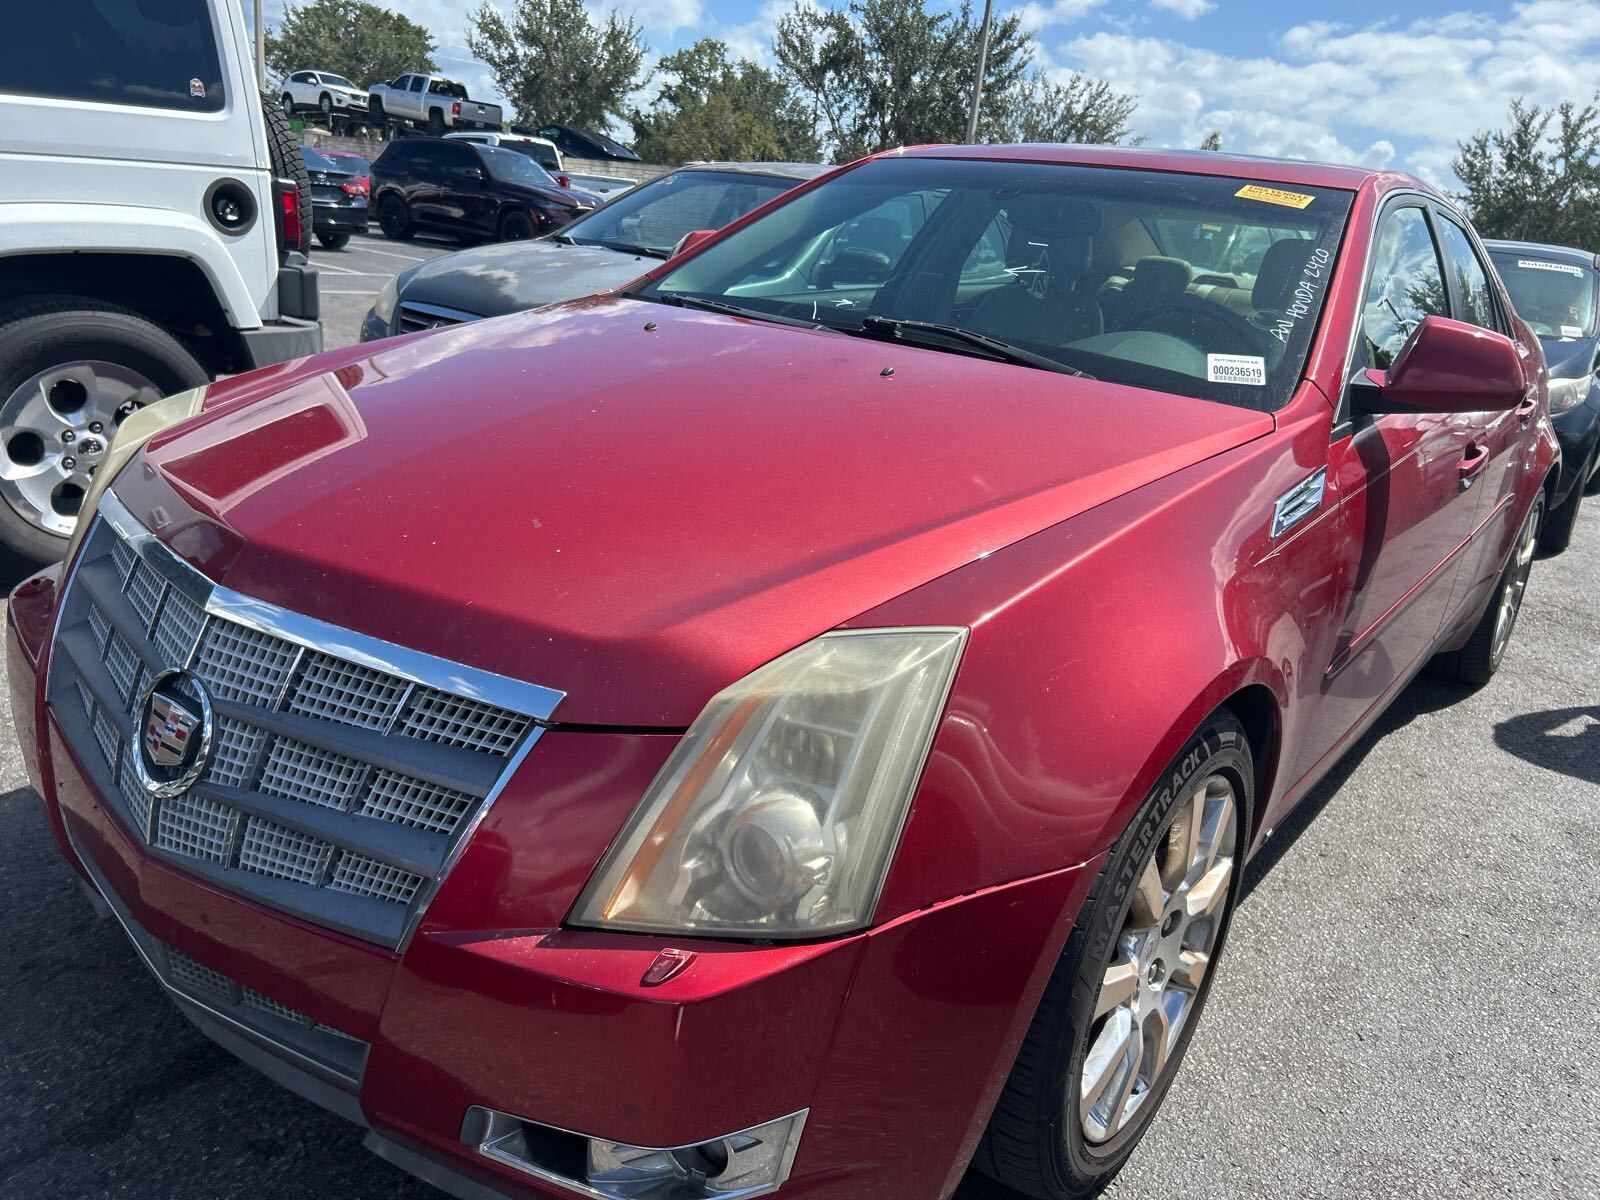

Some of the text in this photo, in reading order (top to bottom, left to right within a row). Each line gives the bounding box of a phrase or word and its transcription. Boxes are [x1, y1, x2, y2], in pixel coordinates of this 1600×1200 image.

[1269, 248, 1330, 344] AN HONDA 2420
[1213, 365, 1262, 378] 000236519
[1089, 747, 1201, 962] MASTERTRACK
